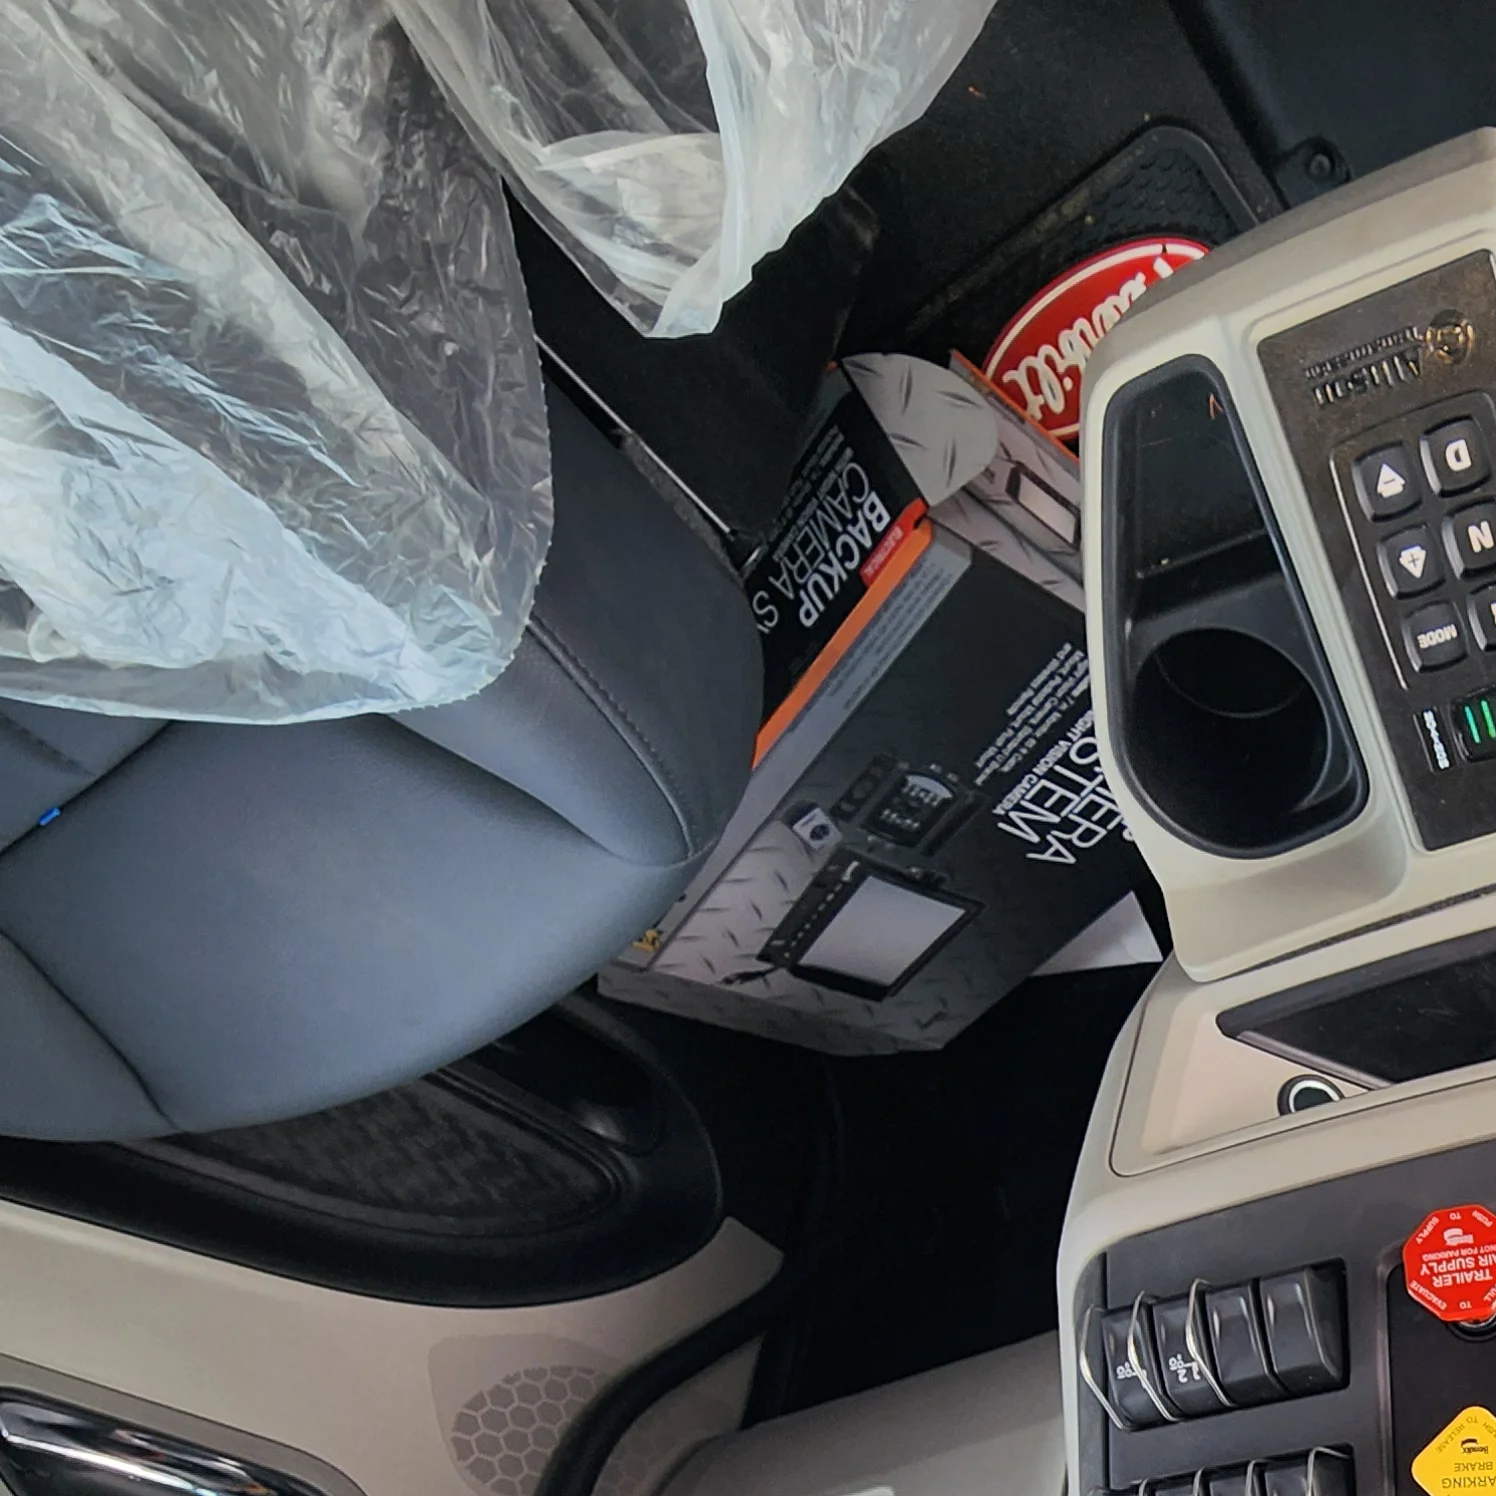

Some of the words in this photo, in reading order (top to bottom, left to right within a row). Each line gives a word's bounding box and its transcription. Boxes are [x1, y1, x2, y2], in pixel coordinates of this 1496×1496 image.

[1003, 257, 1173, 421] erbilt
[1445, 439, 1472, 472] D
[768, 463, 868, 599] CAMERA
[1468, 521, 1494, 553] N
[799, 491, 891, 627] BACKUP
[752, 591, 778, 634] S
[1417, 623, 1458, 650] MODE
[1032, 740, 1071, 776] VISION
[992, 773, 1037, 815] CAMERA
[1026, 787, 1122, 864] ERA
[1450, 1212, 1461, 1220] TO
[1472, 1210, 1493, 1228] PUSH
[1416, 1217, 1439, 1244] SUPPLY
[1422, 1250, 1459, 1261] PARKING
[1460, 1247, 1478, 1256] FOR
[1480, 1244, 1496, 1254] NOT
[1420, 1257, 1475, 1276] SUPPLY
[1432, 1268, 1492, 1288] TRAILER
[1409, 1280, 1447, 1310] EVACUATE
[1460, 1301, 1472, 1309] TO
[1436, 1424, 1465, 1454] RELEASE
[1454, 1462, 1493, 1472] BRAKE
